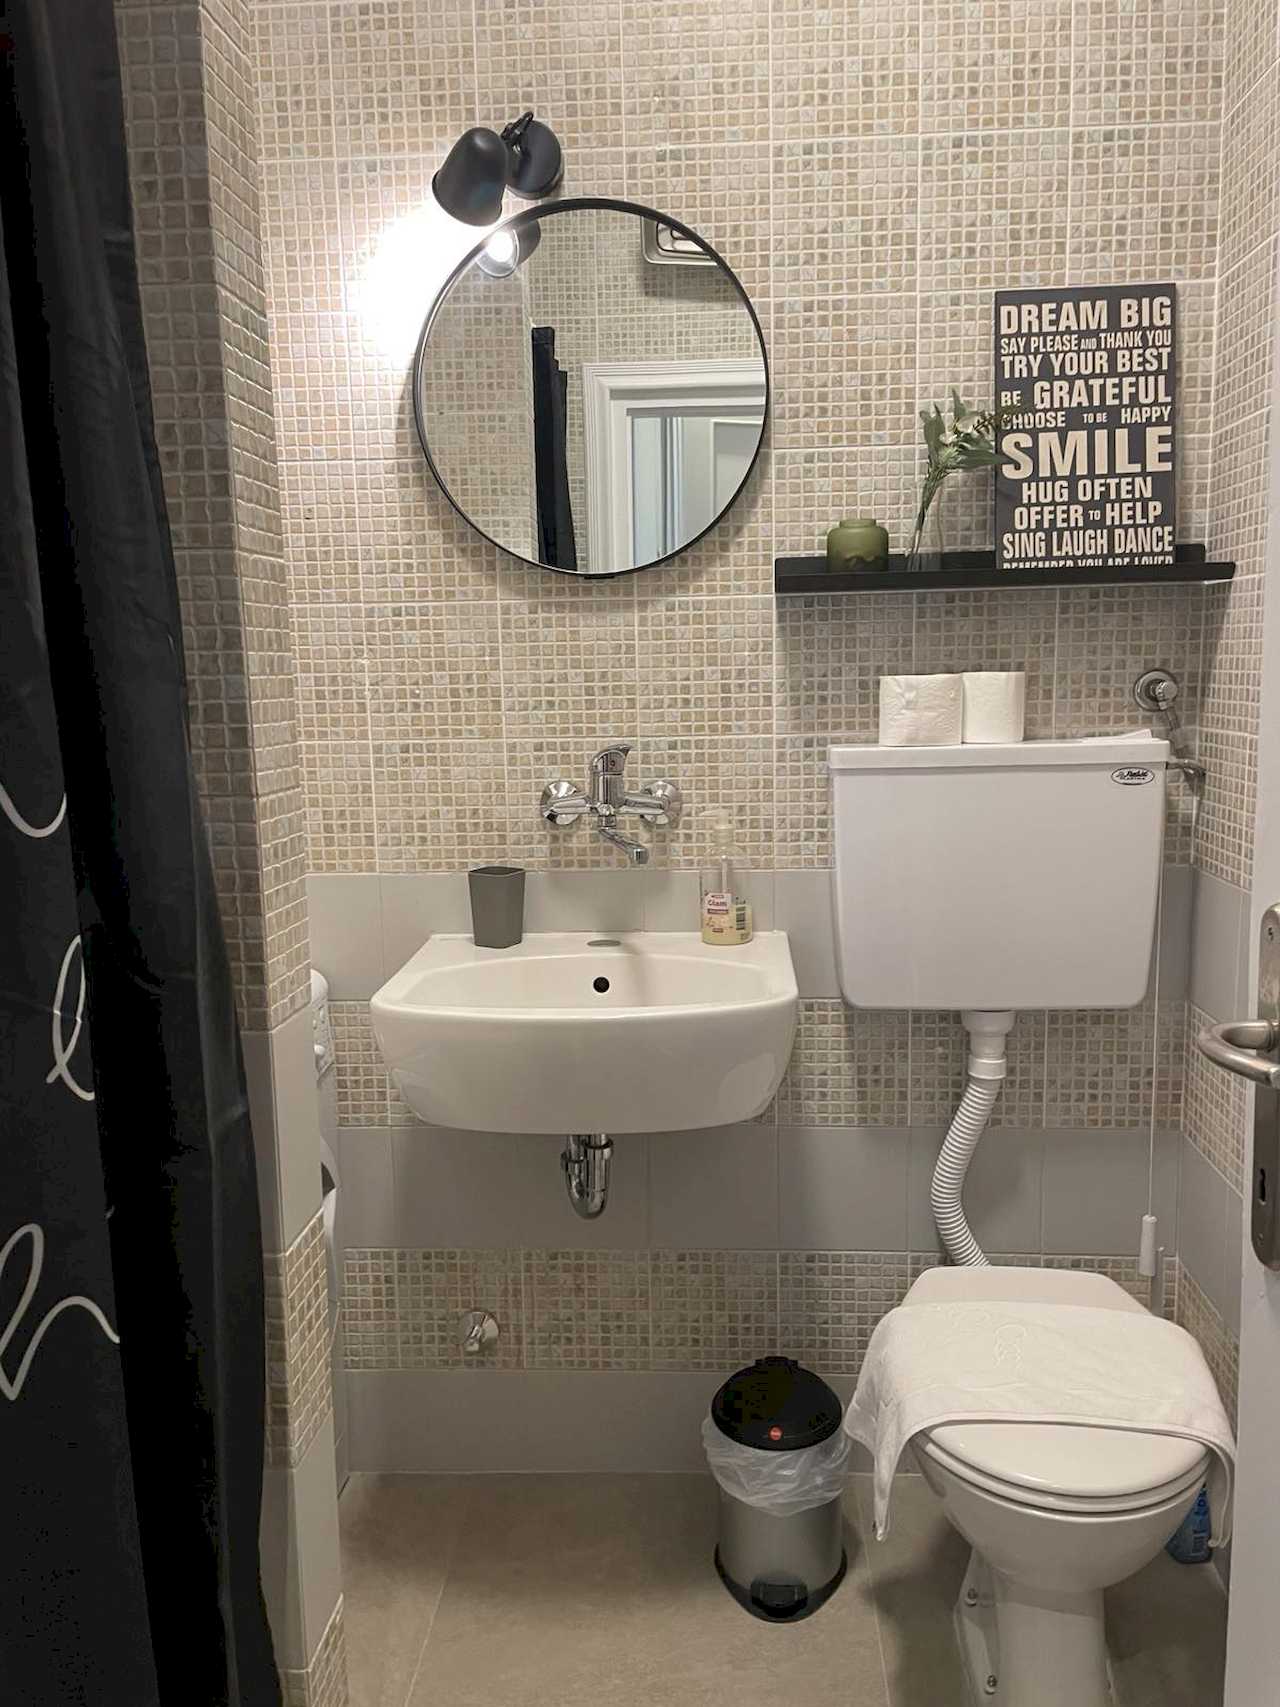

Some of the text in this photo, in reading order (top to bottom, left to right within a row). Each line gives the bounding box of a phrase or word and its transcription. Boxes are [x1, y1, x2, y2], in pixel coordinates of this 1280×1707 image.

[1000, 296, 1172, 334] DREAM BIG
[1001, 329, 1172, 354] SAY PLEASE AND THANK YOU
[1001, 347, 1172, 379] TRY YOUR BEST
[1001, 375, 1172, 410] BE GRATEFUL
[1083, 413, 1094, 424] TO
[1096, 412, 1108, 423] BE
[1121, 406, 1172, 424] HAPPY
[1002, 426, 1172, 480] SMILE
[1022, 476, 1152, 504] HUG OFTEN
[1014, 501, 1162, 530] OFFER TO HELP
[1003, 526, 1173, 559] SING LAUGH DANCE
